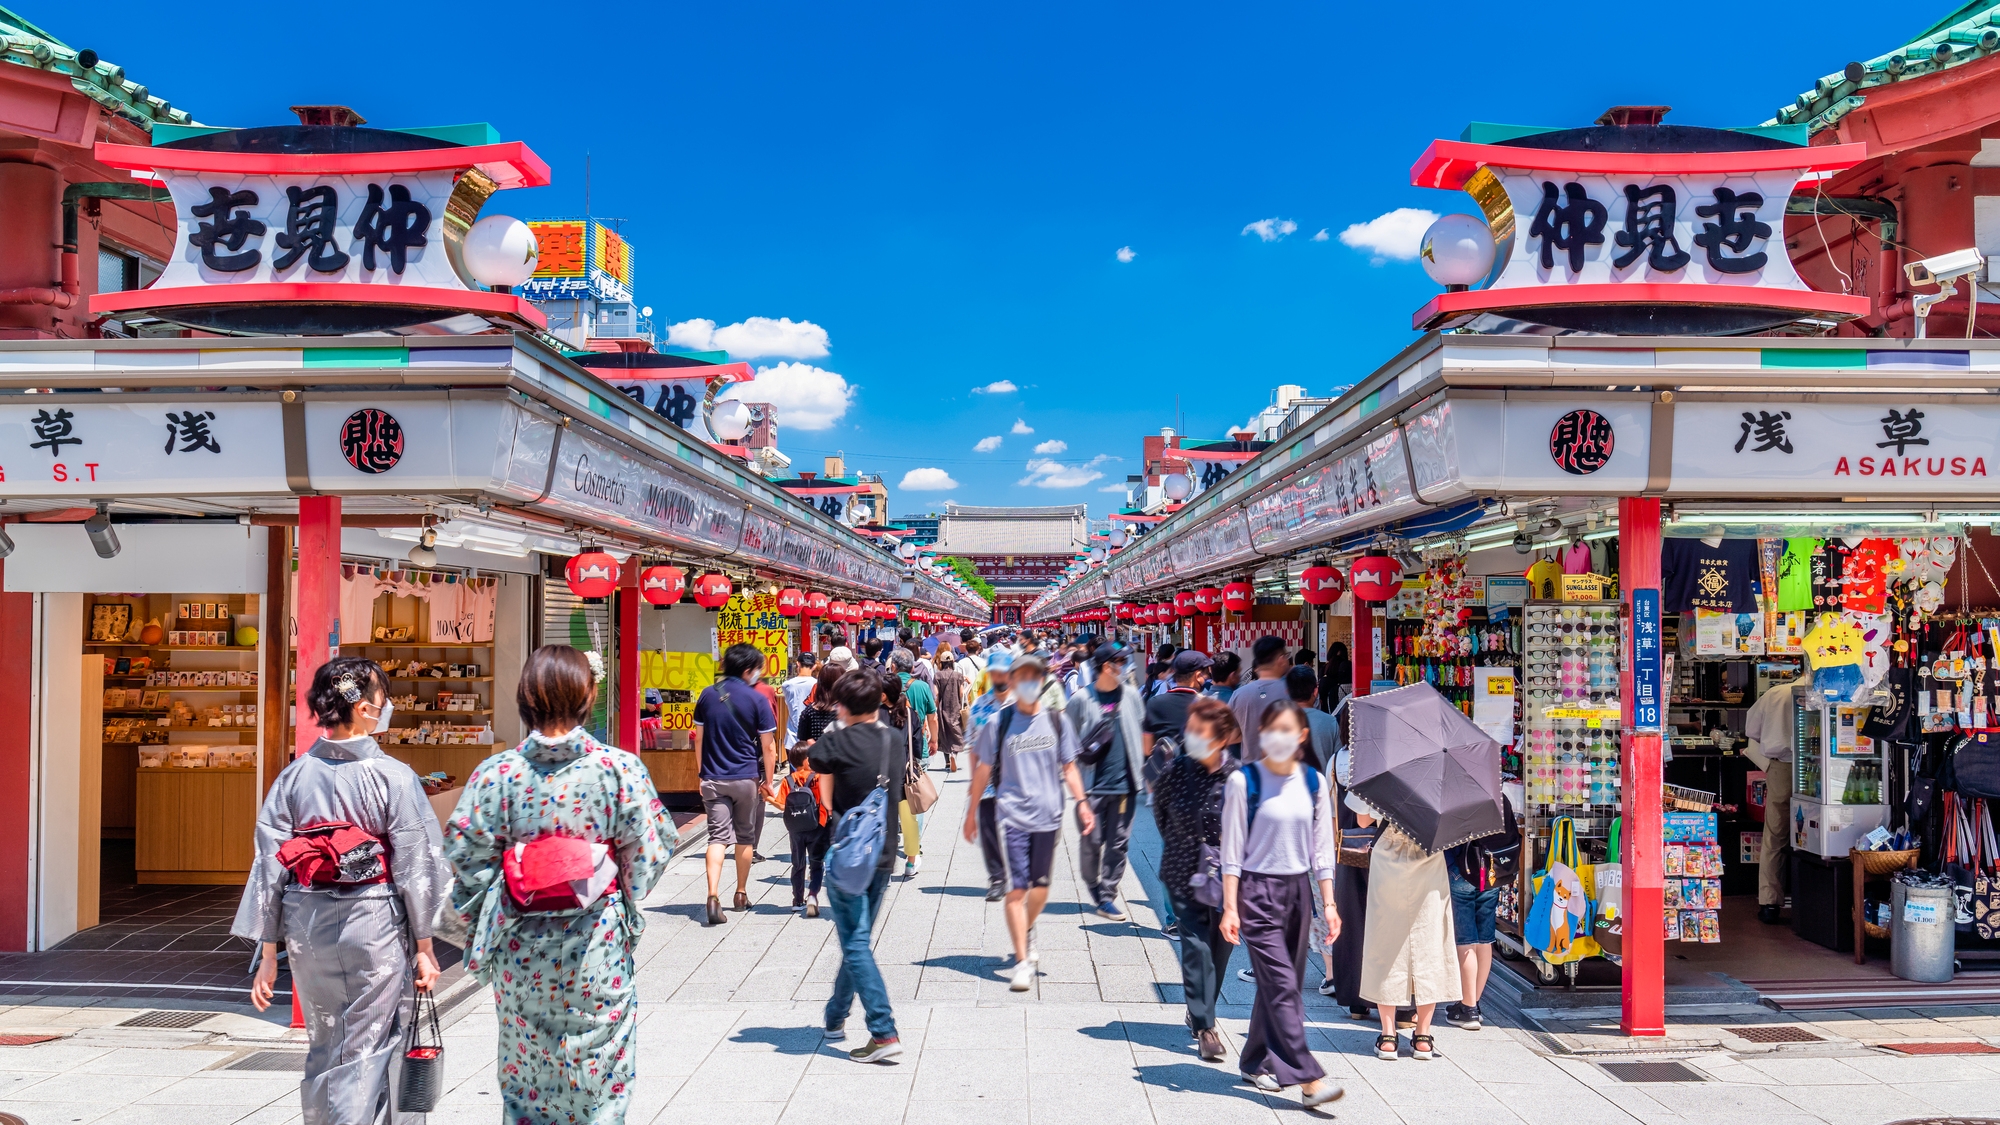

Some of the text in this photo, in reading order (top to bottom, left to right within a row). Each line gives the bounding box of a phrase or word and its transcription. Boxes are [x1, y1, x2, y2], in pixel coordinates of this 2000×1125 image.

[532, 223, 583, 273] 薬
[1529, 182, 1772, 274] 仲見世
[574, 453, 627, 507] Cosmetics
[643, 483, 696, 528] MONKADO
[1834, 456, 1987, 477] ASAKUSA
[1639, 707, 1656, 723] 18
